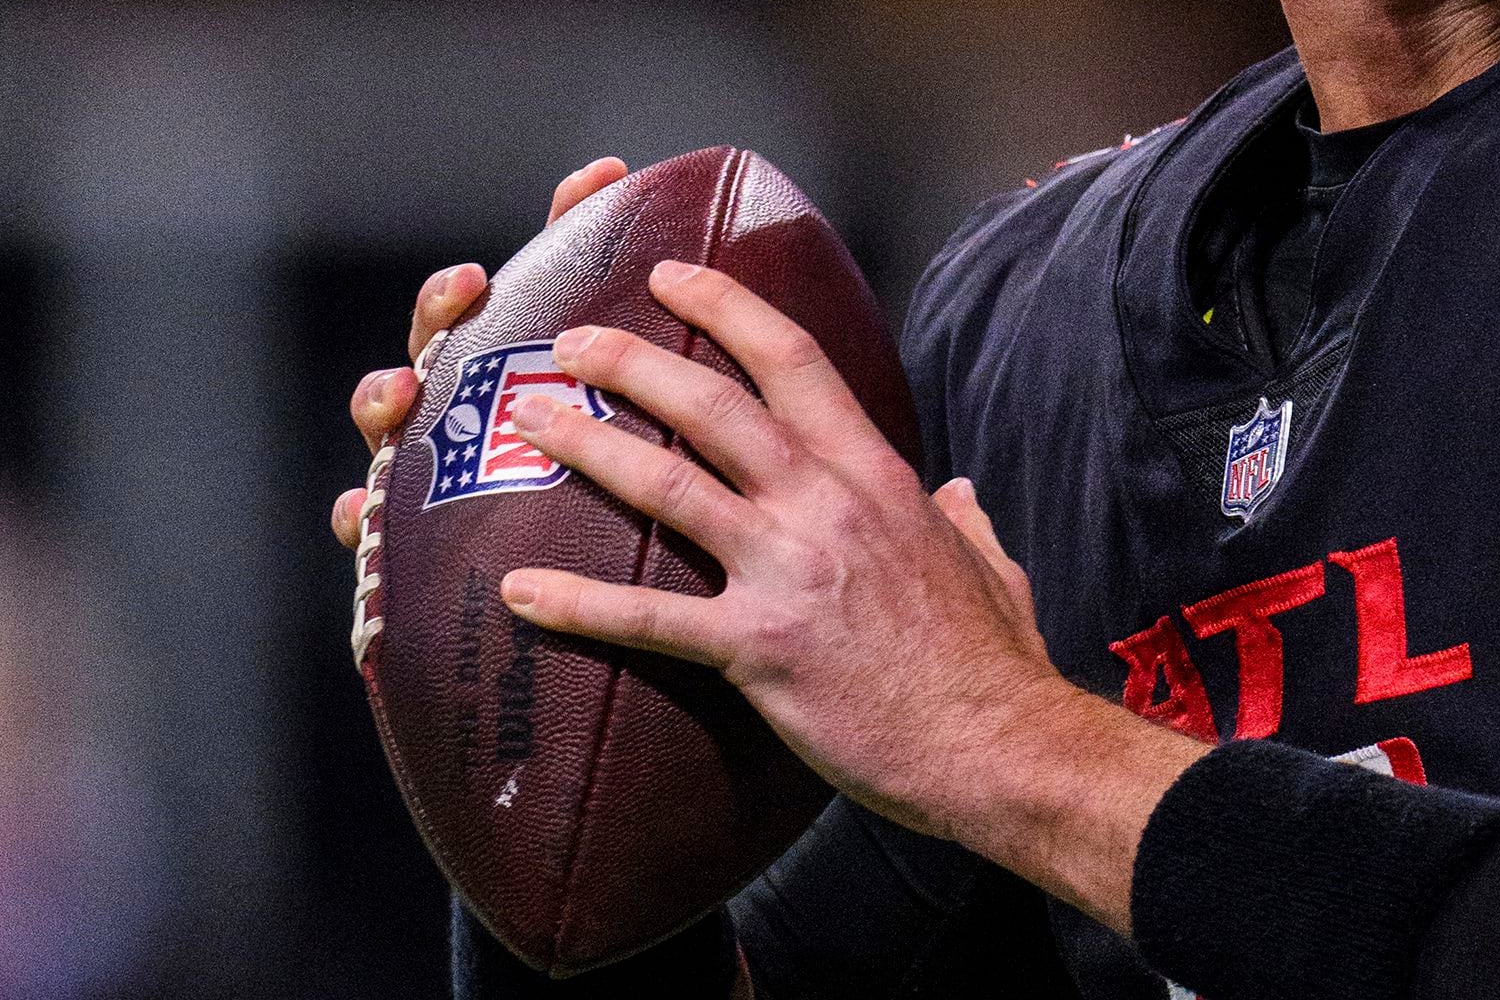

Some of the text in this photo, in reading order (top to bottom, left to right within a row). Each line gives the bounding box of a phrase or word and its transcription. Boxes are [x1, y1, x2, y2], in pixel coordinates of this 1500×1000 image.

[1228, 448, 1270, 500] NFL
[496, 618, 536, 762] Wilso
[1109, 537, 1473, 746] ATL
